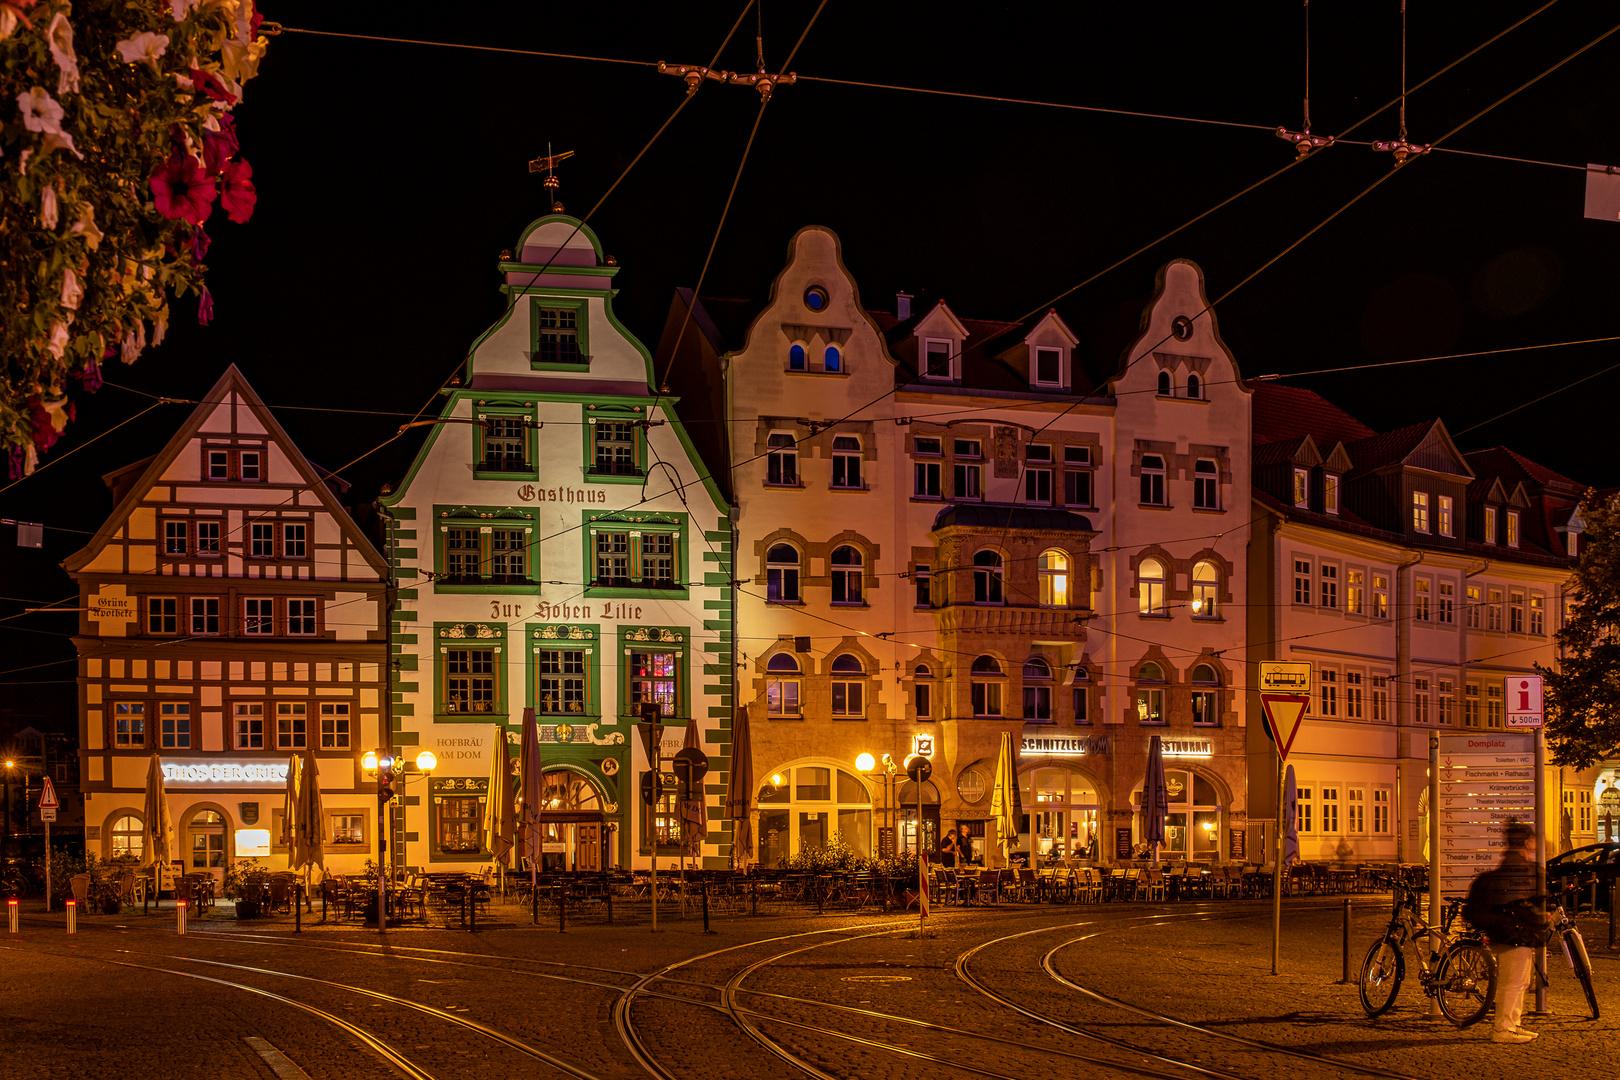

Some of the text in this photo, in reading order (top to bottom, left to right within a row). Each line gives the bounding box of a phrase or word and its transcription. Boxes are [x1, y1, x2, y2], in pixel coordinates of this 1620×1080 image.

[516, 483, 607, 505] Gasthaus
[97, 597, 128, 608] Grüne
[489, 599, 643, 622] Zur Hohen Lilie
[1519, 716, 1540, 724] 500m
[436, 736, 484, 748] HOFBRÄU
[1467, 740, 1506, 749] Domplatz
[440, 750, 482, 760] AM DOM
[166, 767, 288, 779] THOS DER GRIEC
